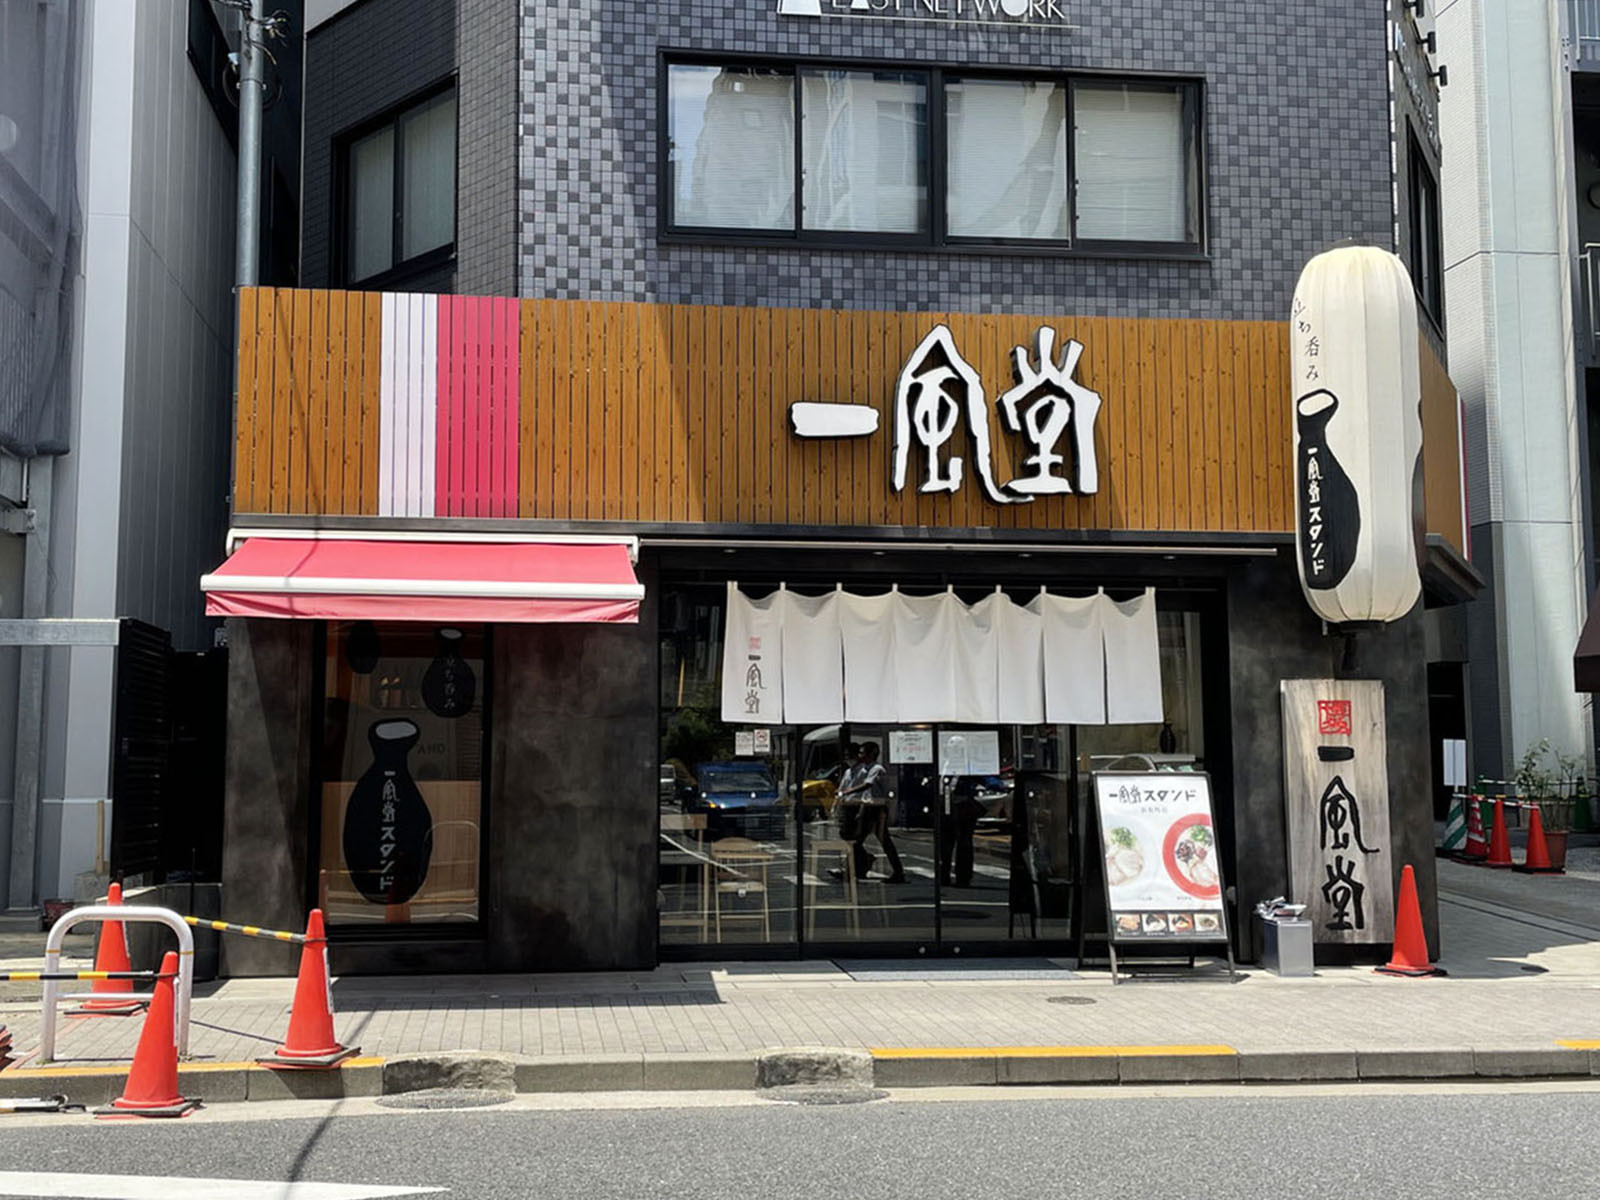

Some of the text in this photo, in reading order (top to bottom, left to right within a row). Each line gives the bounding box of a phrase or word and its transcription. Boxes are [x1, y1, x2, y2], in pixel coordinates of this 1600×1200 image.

[789, 323, 1101, 504] 一風堂
[1307, 447, 1325, 576] 一風堂スタンド
[744, 654, 767, 714] 一風堂
[380, 770, 400, 890] 一風堂スタンド
[1108, 784, 1197, 804] 一風堂スタンド
[1317, 745, 1381, 931] 一風堂
